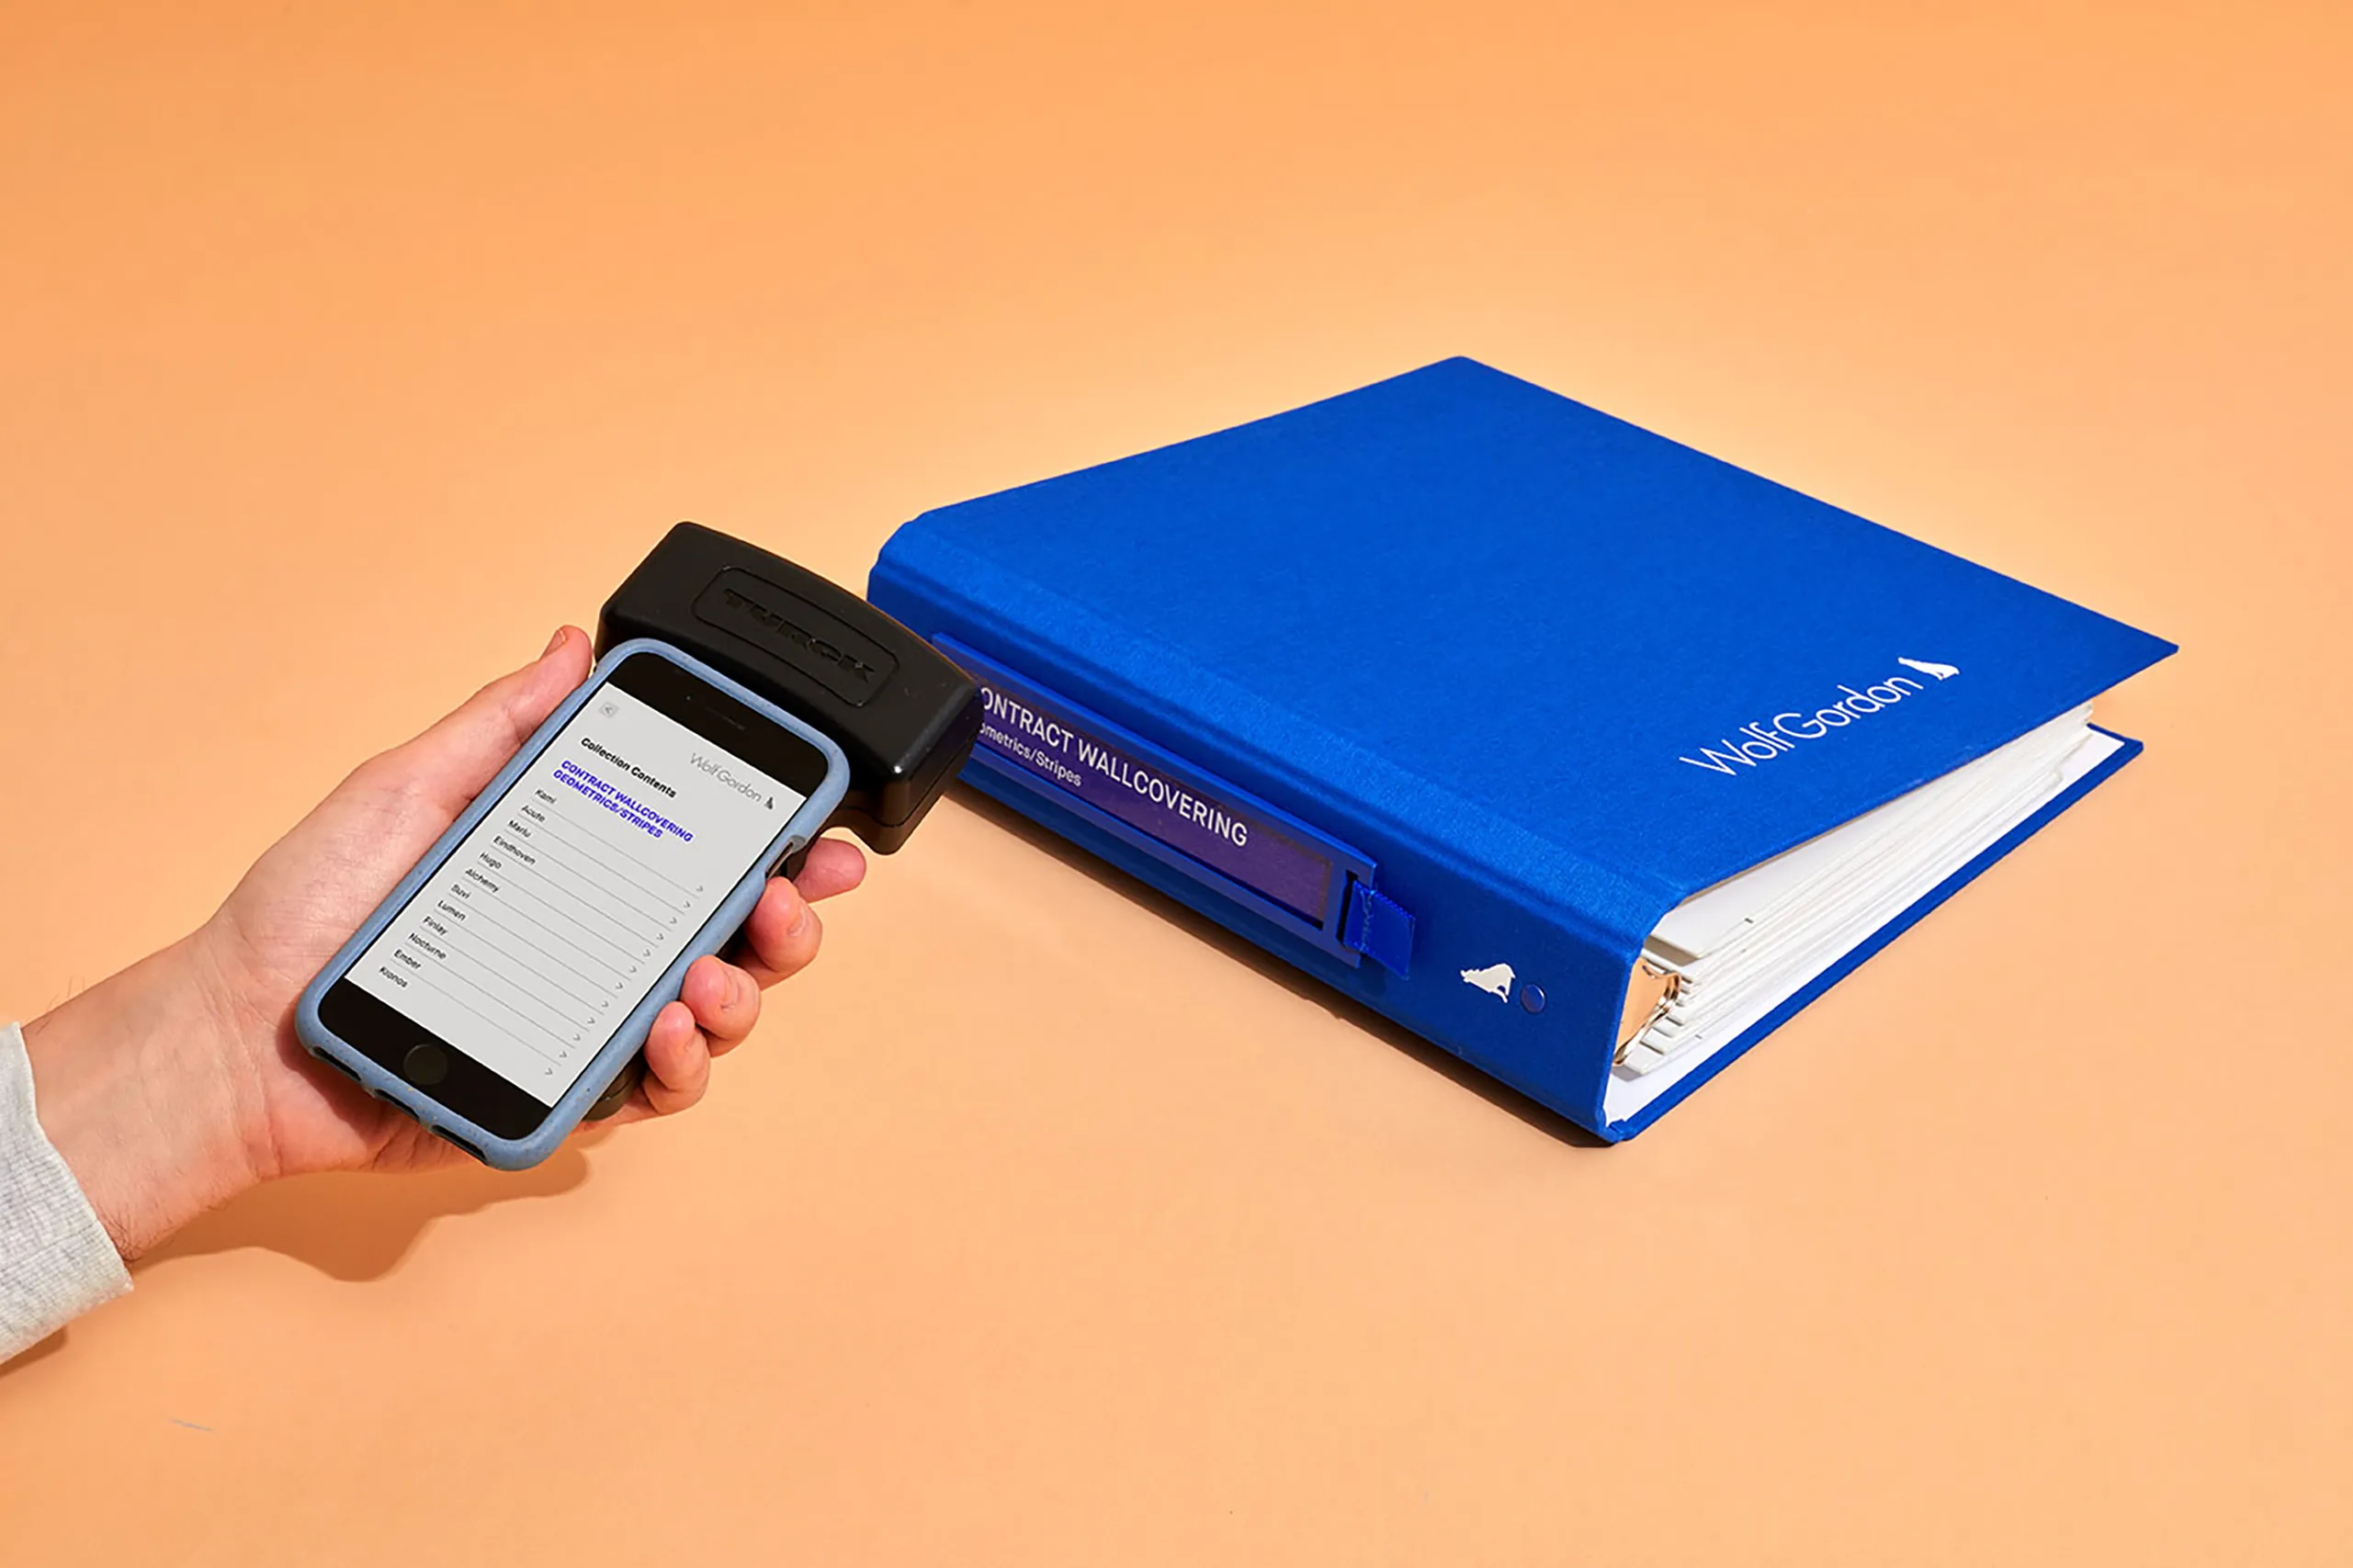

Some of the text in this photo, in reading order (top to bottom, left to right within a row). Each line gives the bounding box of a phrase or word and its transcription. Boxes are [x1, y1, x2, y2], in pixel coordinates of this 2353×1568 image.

[1679, 676, 1923, 775] WolfGordon
[979, 723, 1082, 787] ometrics/Stripes
[980, 687, 1248, 847] ONTRACT WALLCOVERING
[581, 738, 676, 798] Collection Contents
[535, 789, 557, 805] Kami
[553, 770, 663, 839] GEOMETRICS/STRIPES
[560, 761, 694, 841] CONTRACT WALLCOVERING
[521, 805, 546, 822] Acute
[479, 852, 502, 870] Hugo
[492, 836, 536, 864] Eindhoven
[450, 884, 471, 899] Suvi
[465, 868, 499, 893] Alchemy
[437, 899, 466, 921] Lumen
[423, 916, 447, 936] Finlay
[409, 932, 447, 960] Nocturne
[393, 949, 421, 970] Ember
[379, 966, 408, 987] Kronos
